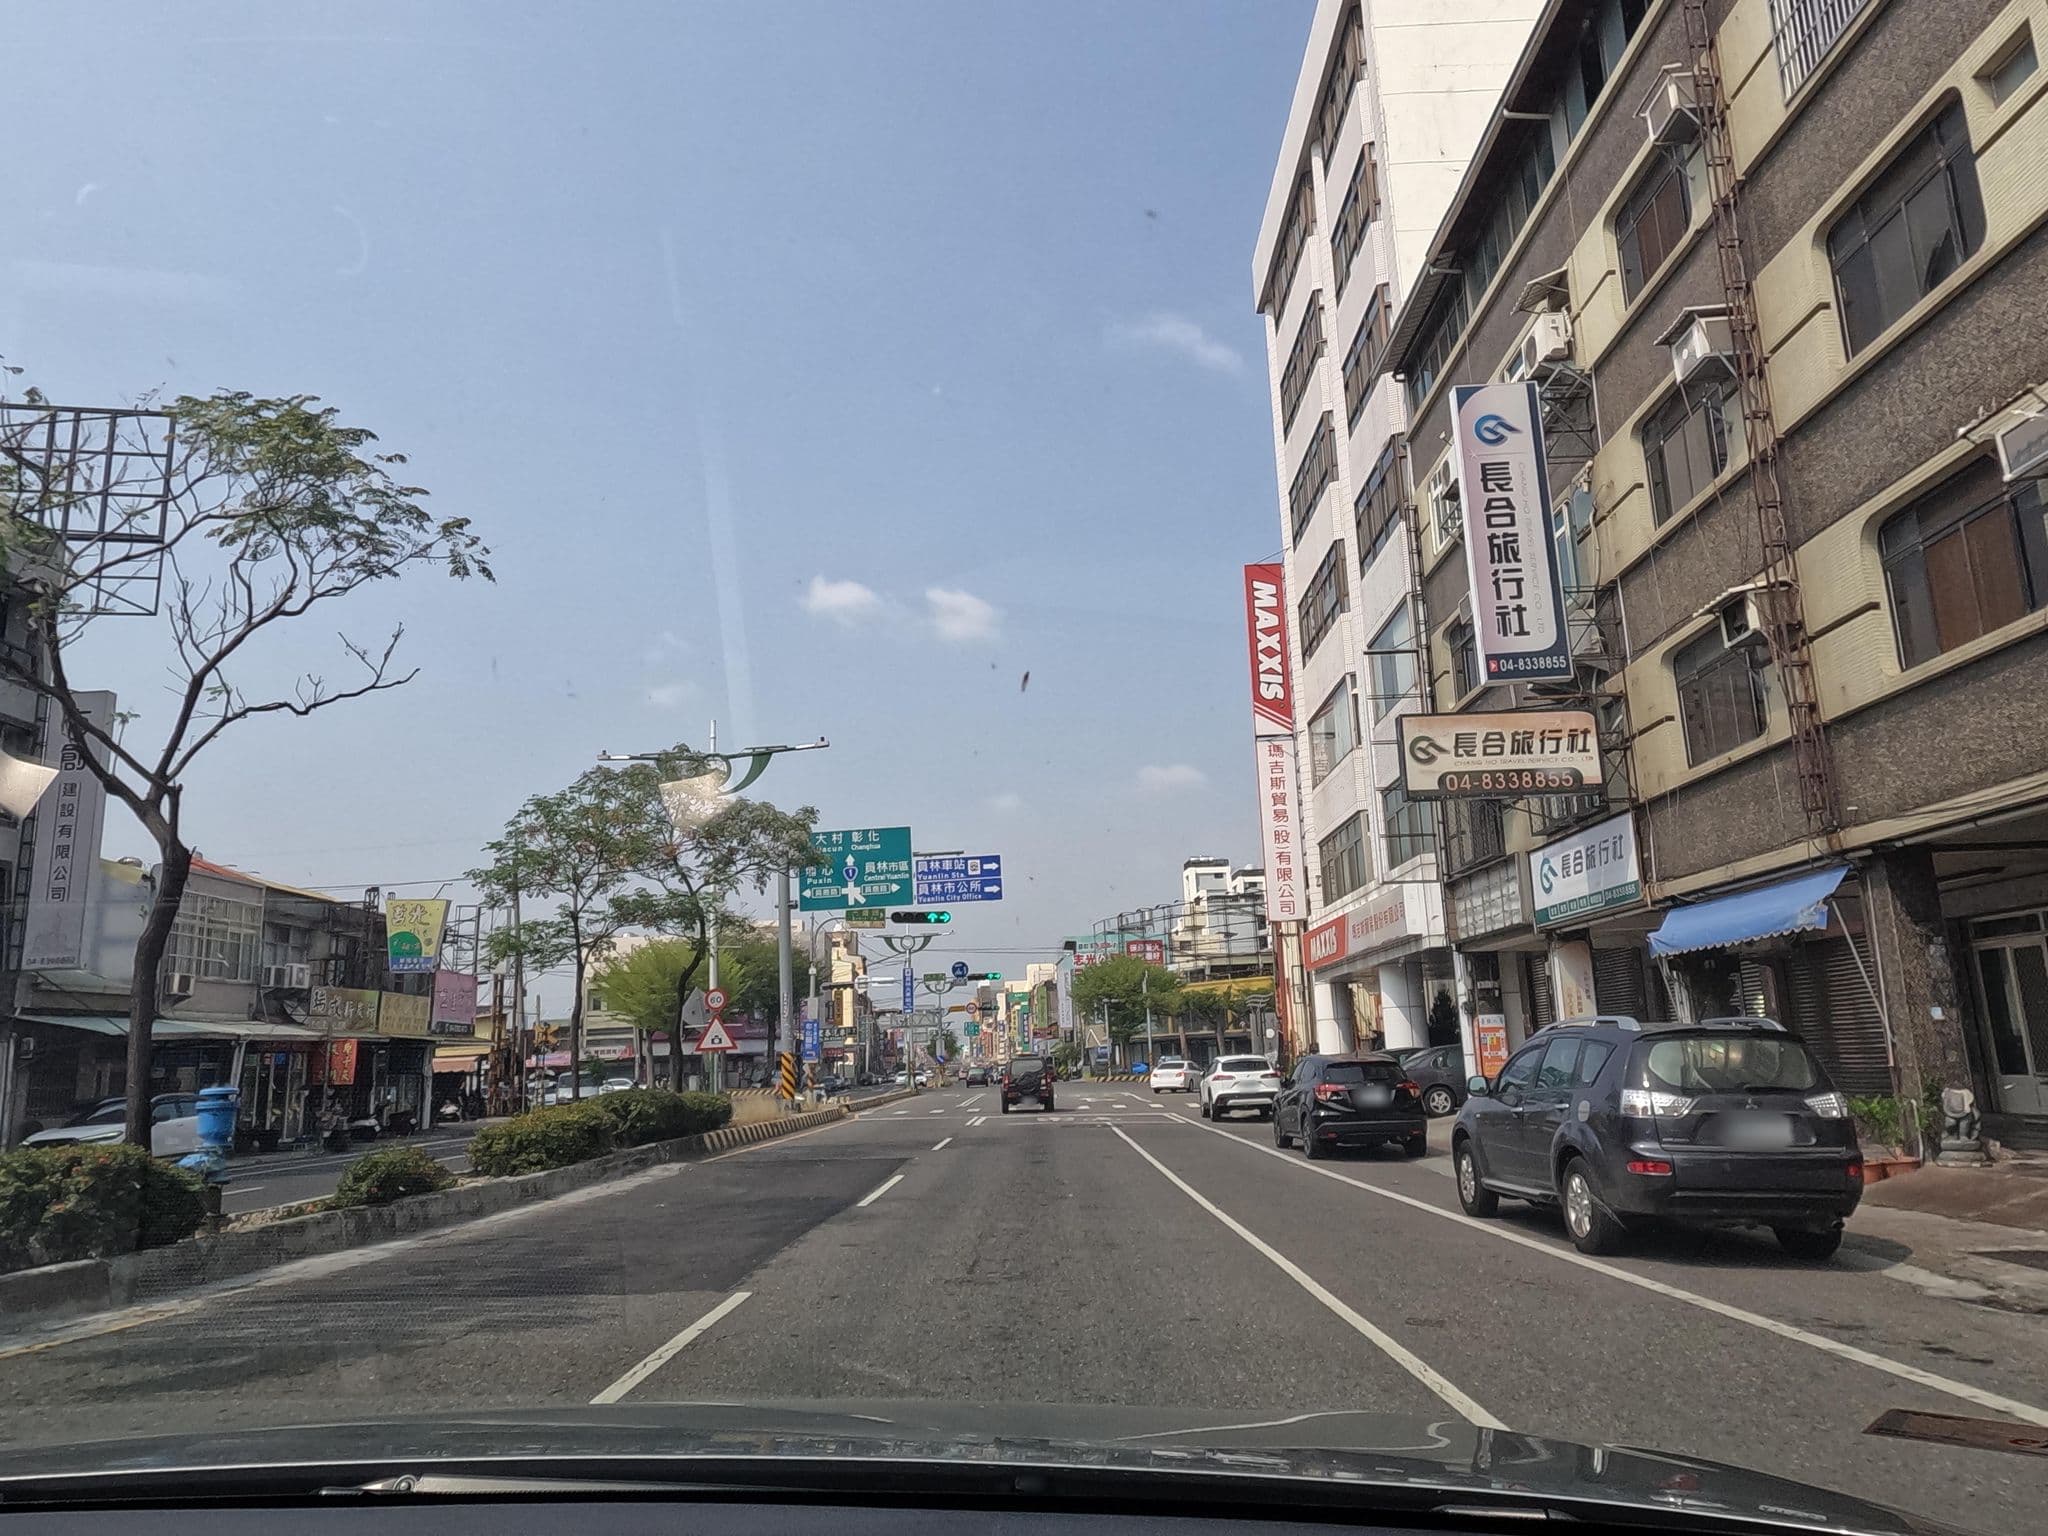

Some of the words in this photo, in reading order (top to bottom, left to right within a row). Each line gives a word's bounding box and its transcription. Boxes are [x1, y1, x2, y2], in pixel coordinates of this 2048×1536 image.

[1480, 460, 1531, 638] 長合旅行社
[1252, 580, 1285, 701] MAXXIS
[1500, 655, 1567, 673] 04-8338855
[1453, 728, 1591, 757] 長合旅行社
[1445, 771, 1574, 791] 04-8338855
[815, 833, 843, 845] 大村
[852, 830, 880, 842] 彰化
[1268, 744, 1296, 915] 瑪吉斯貿易(股)有限公司
[51, 782, 77, 902] 建設有限公司
[865, 860, 909, 873] 員林市區
[918, 859, 965, 872] 員林車站
[1561, 834, 1624, 879] 長合旅行社
[918, 880, 982, 895] 員林市公所
[919, 895, 945, 903] Yuanlin
[1310, 925, 1338, 964] MAXXIS
